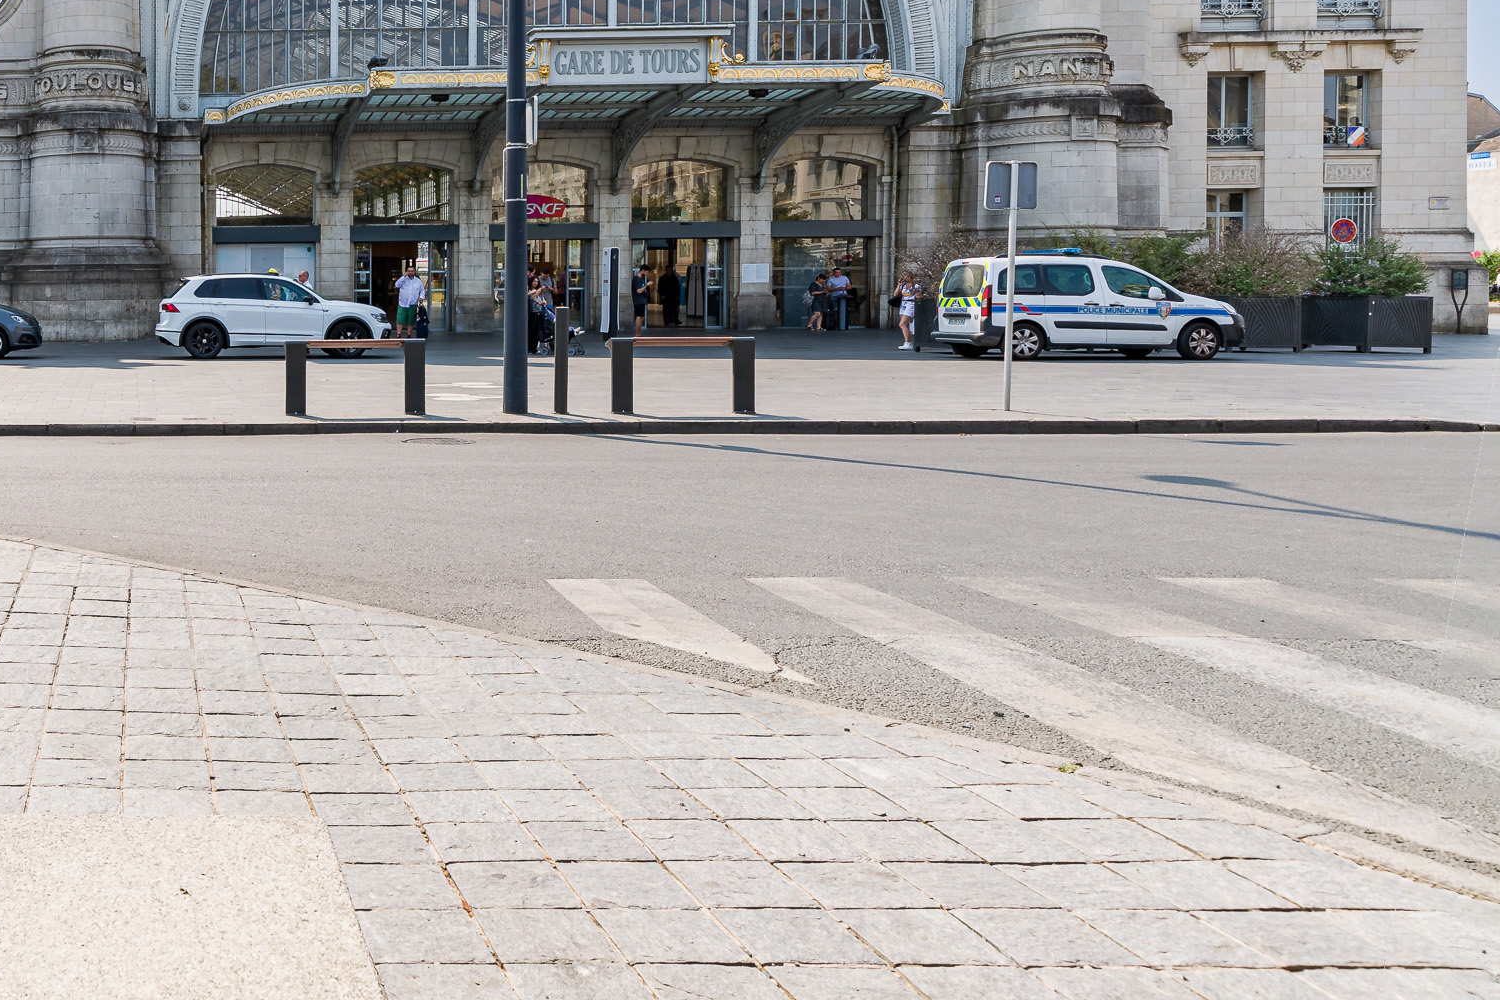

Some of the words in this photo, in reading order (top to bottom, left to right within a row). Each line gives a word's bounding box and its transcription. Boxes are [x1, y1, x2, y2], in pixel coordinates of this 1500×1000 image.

[554, 50, 605, 75] GARE
[610, 50, 634, 75] DE
[639, 48, 701, 74] TOURS
[527, 203, 564, 215] SNCF
[1105, 307, 1148, 315] MUNICIPALE
